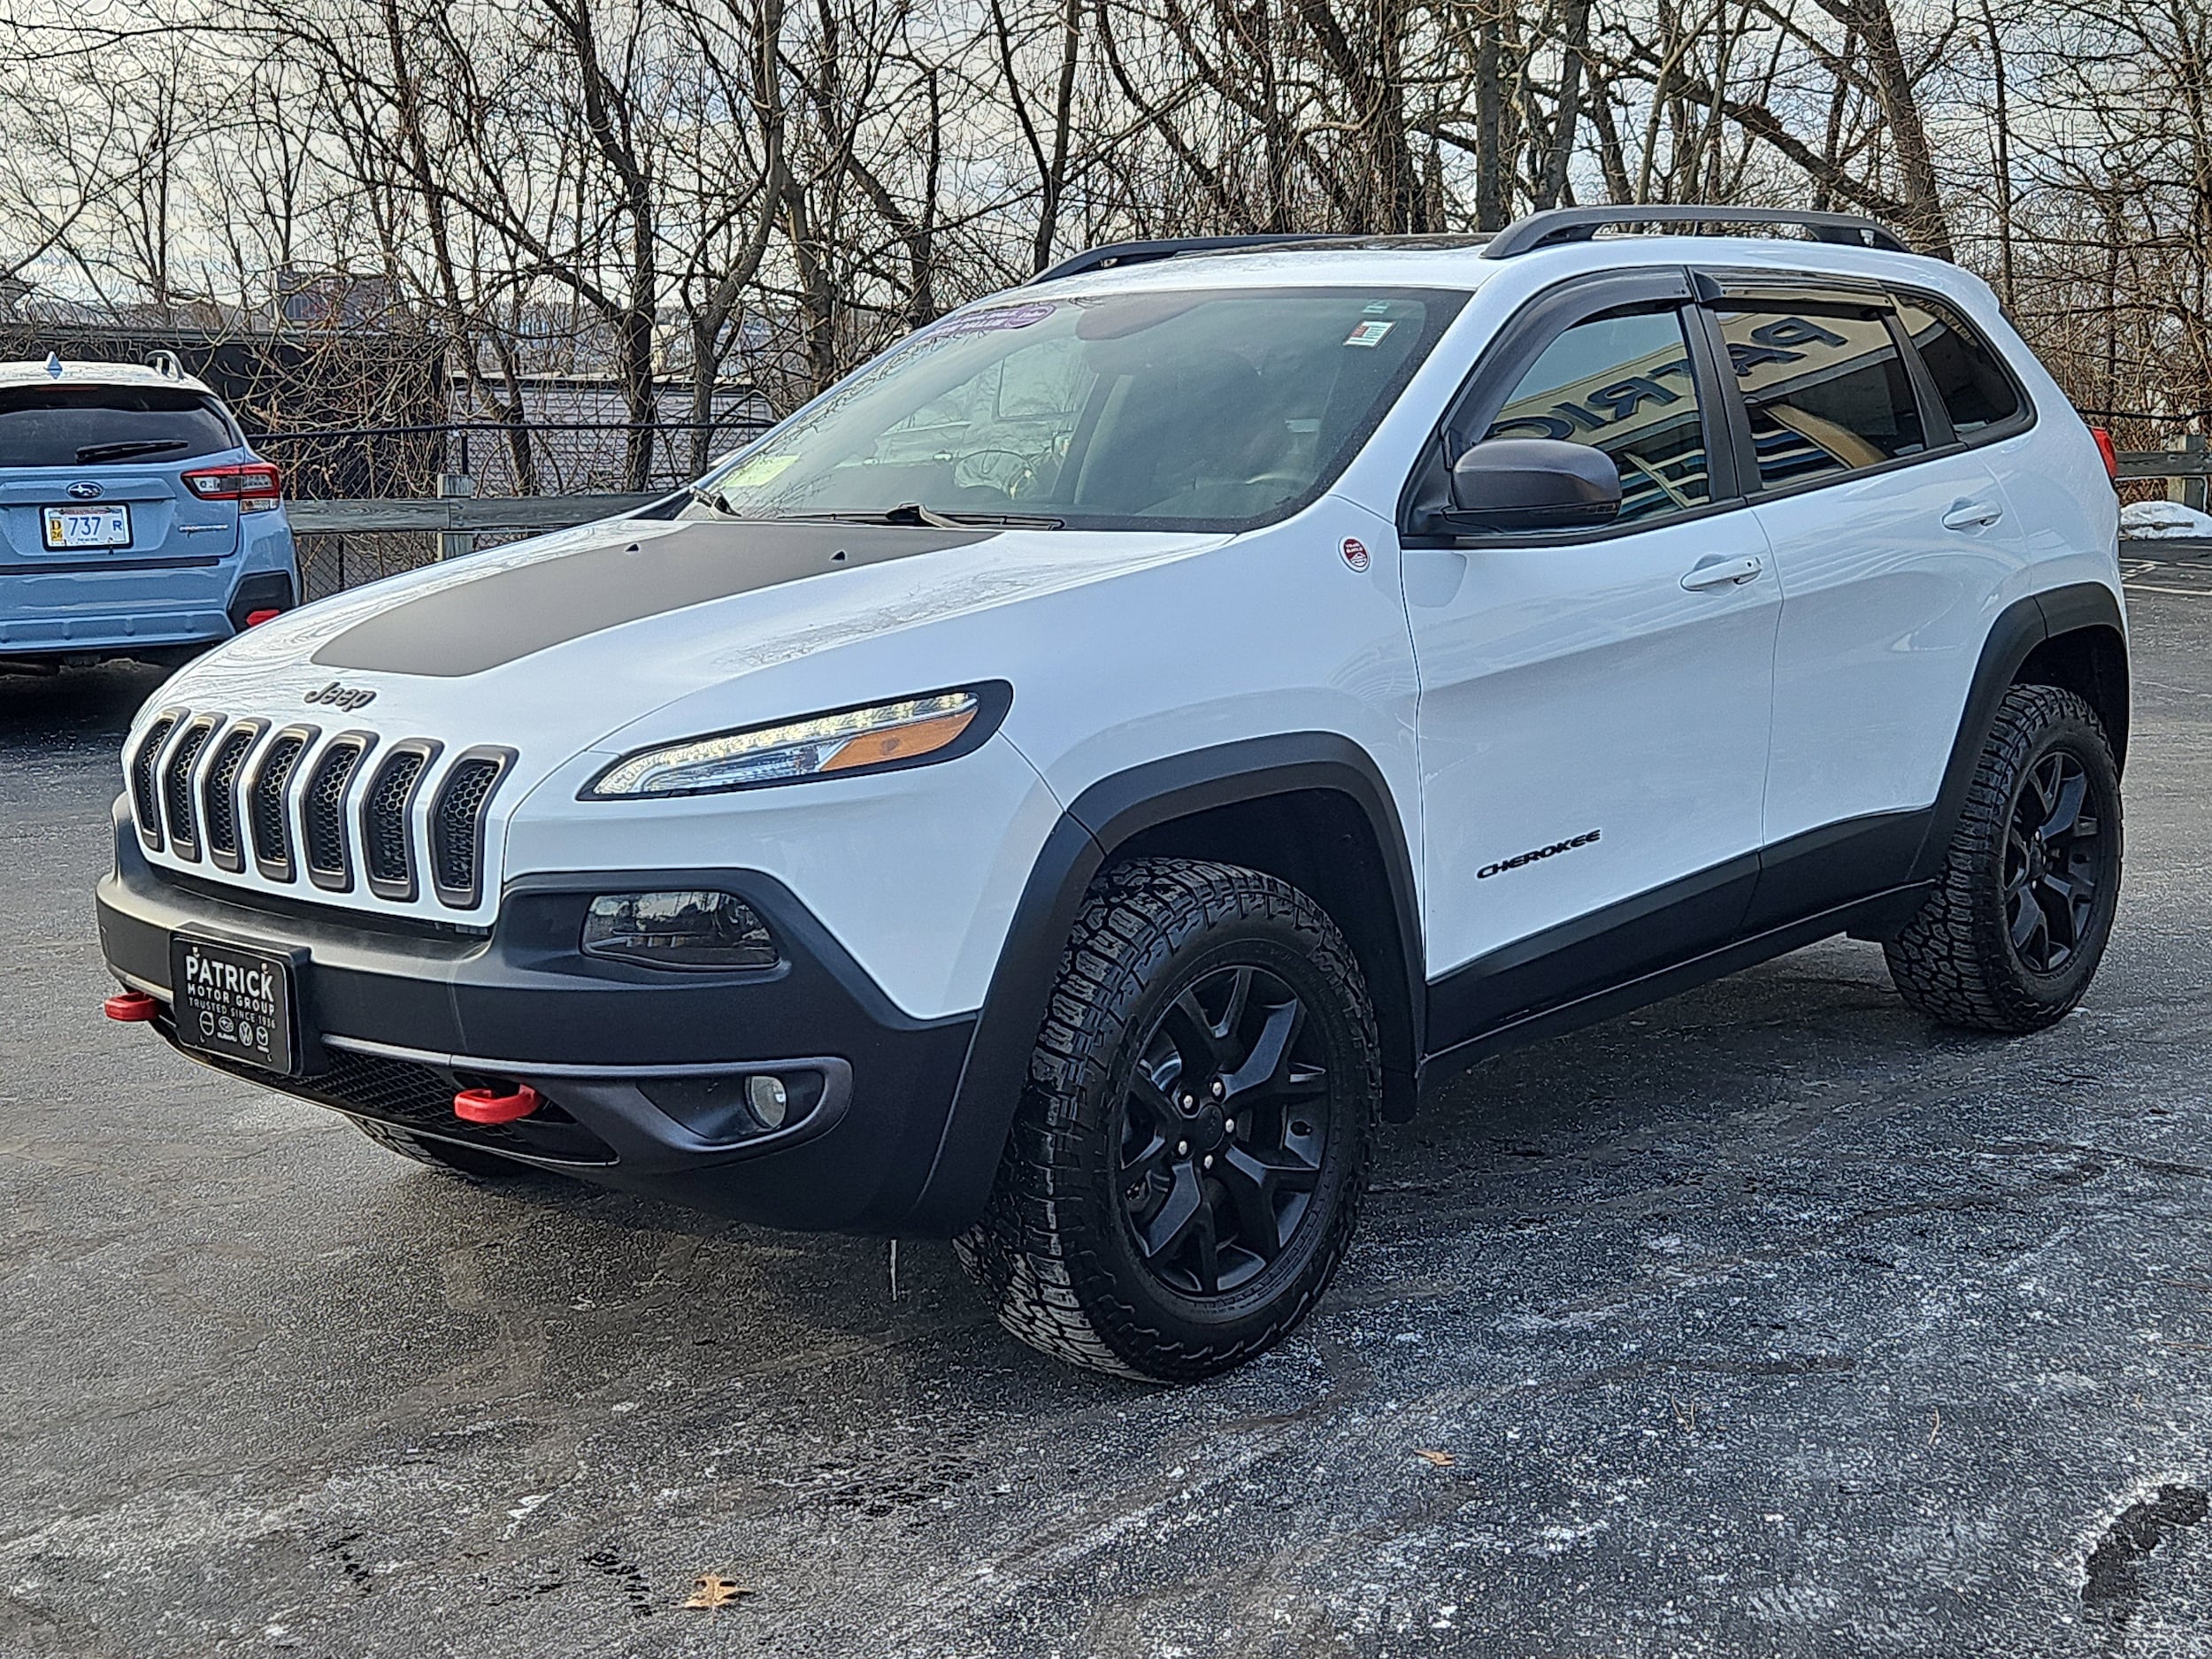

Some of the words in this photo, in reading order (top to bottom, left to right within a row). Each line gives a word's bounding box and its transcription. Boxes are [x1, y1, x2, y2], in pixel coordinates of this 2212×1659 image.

[51, 519, 62, 531] D
[68, 516, 102, 536] 737
[112, 520, 123, 532] R
[303, 681, 377, 712] Jeep
[1477, 829, 1601, 879] CHEROKEE
[185, 955, 274, 1002] PATRICK
[188, 982, 230, 1004] MOTOR
[235, 995, 274, 1016] GROUP
[188, 997, 227, 1015] TRUSTED
[230, 1007, 256, 1023] SINCE
